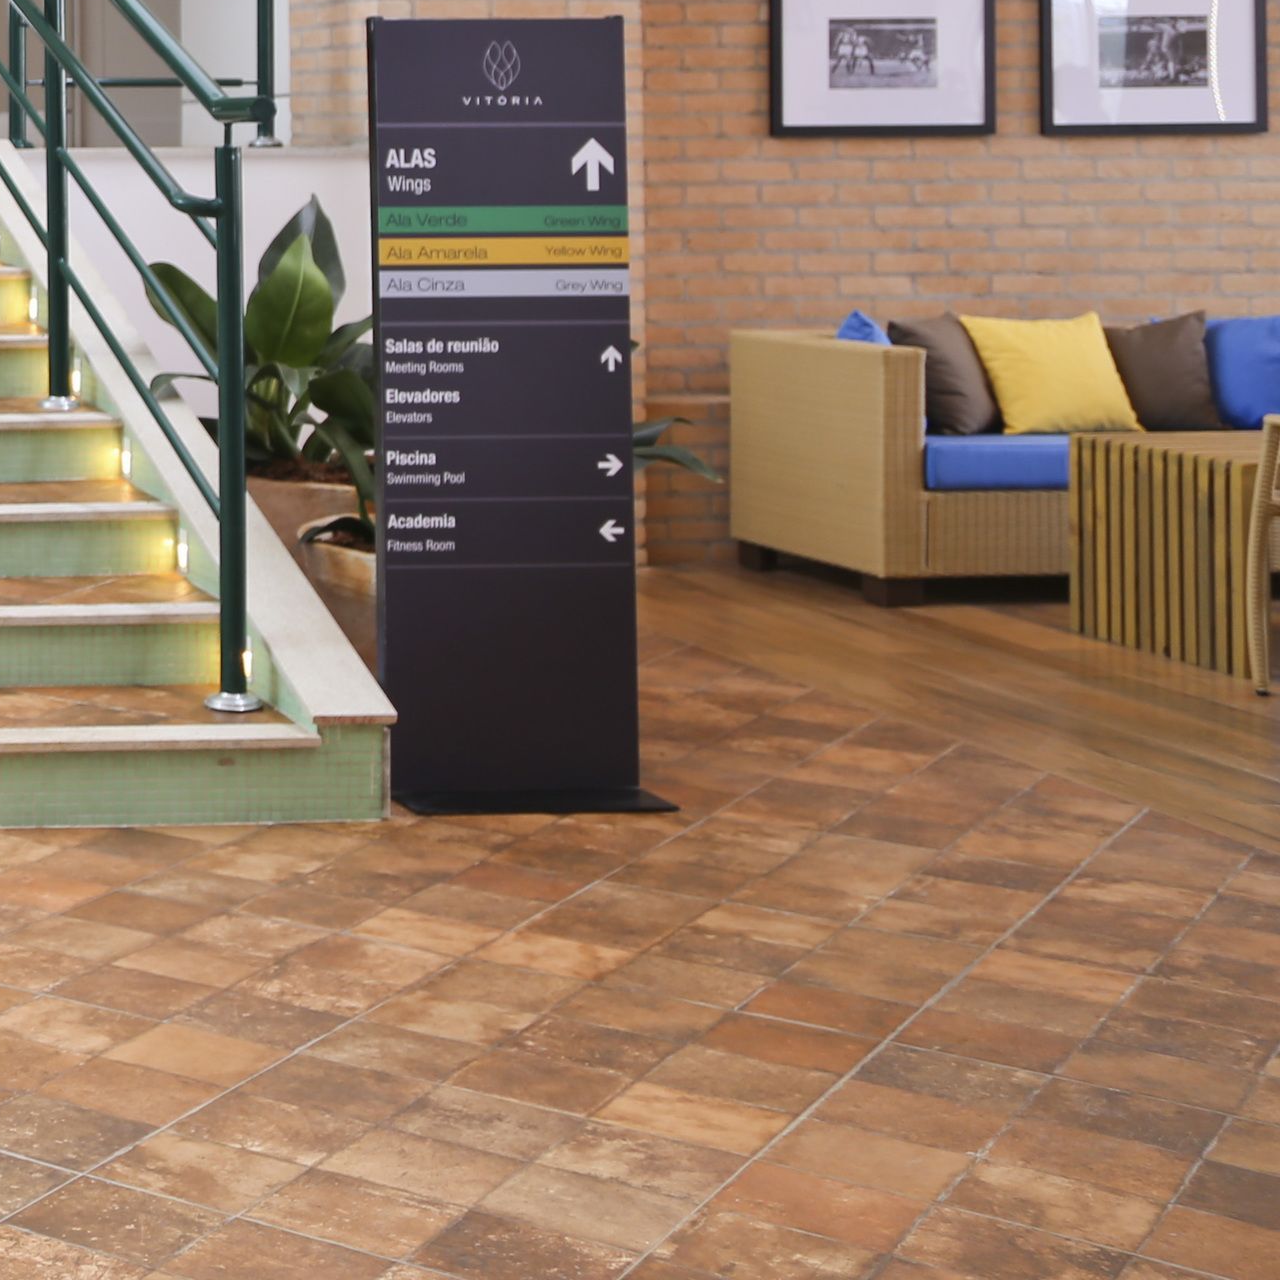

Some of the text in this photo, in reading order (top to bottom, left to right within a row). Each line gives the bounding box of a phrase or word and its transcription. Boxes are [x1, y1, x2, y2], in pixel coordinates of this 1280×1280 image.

[385, 148, 437, 169] ALAS
[387, 175, 432, 196] Wings
[386, 213, 468, 227] Ala Verde
[544, 215, 622, 230] Green Wing
[386, 246, 488, 260] Ala Amarela
[545, 245, 623, 258] Yellow Wing
[387, 277, 465, 292] Ala Cinza
[555, 279, 623, 293] Grey Wing
[385, 337, 500, 354] Salas de reunião
[385, 361, 465, 376] Meeting Rooms
[385, 388, 461, 404] Elevadores
[386, 411, 433, 424] Elevators
[386, 450, 436, 466] Piscina
[386, 471, 466, 486] Swimming Pool
[387, 513, 456, 529] Academia
[387, 539, 455, 552] Fitness Room
